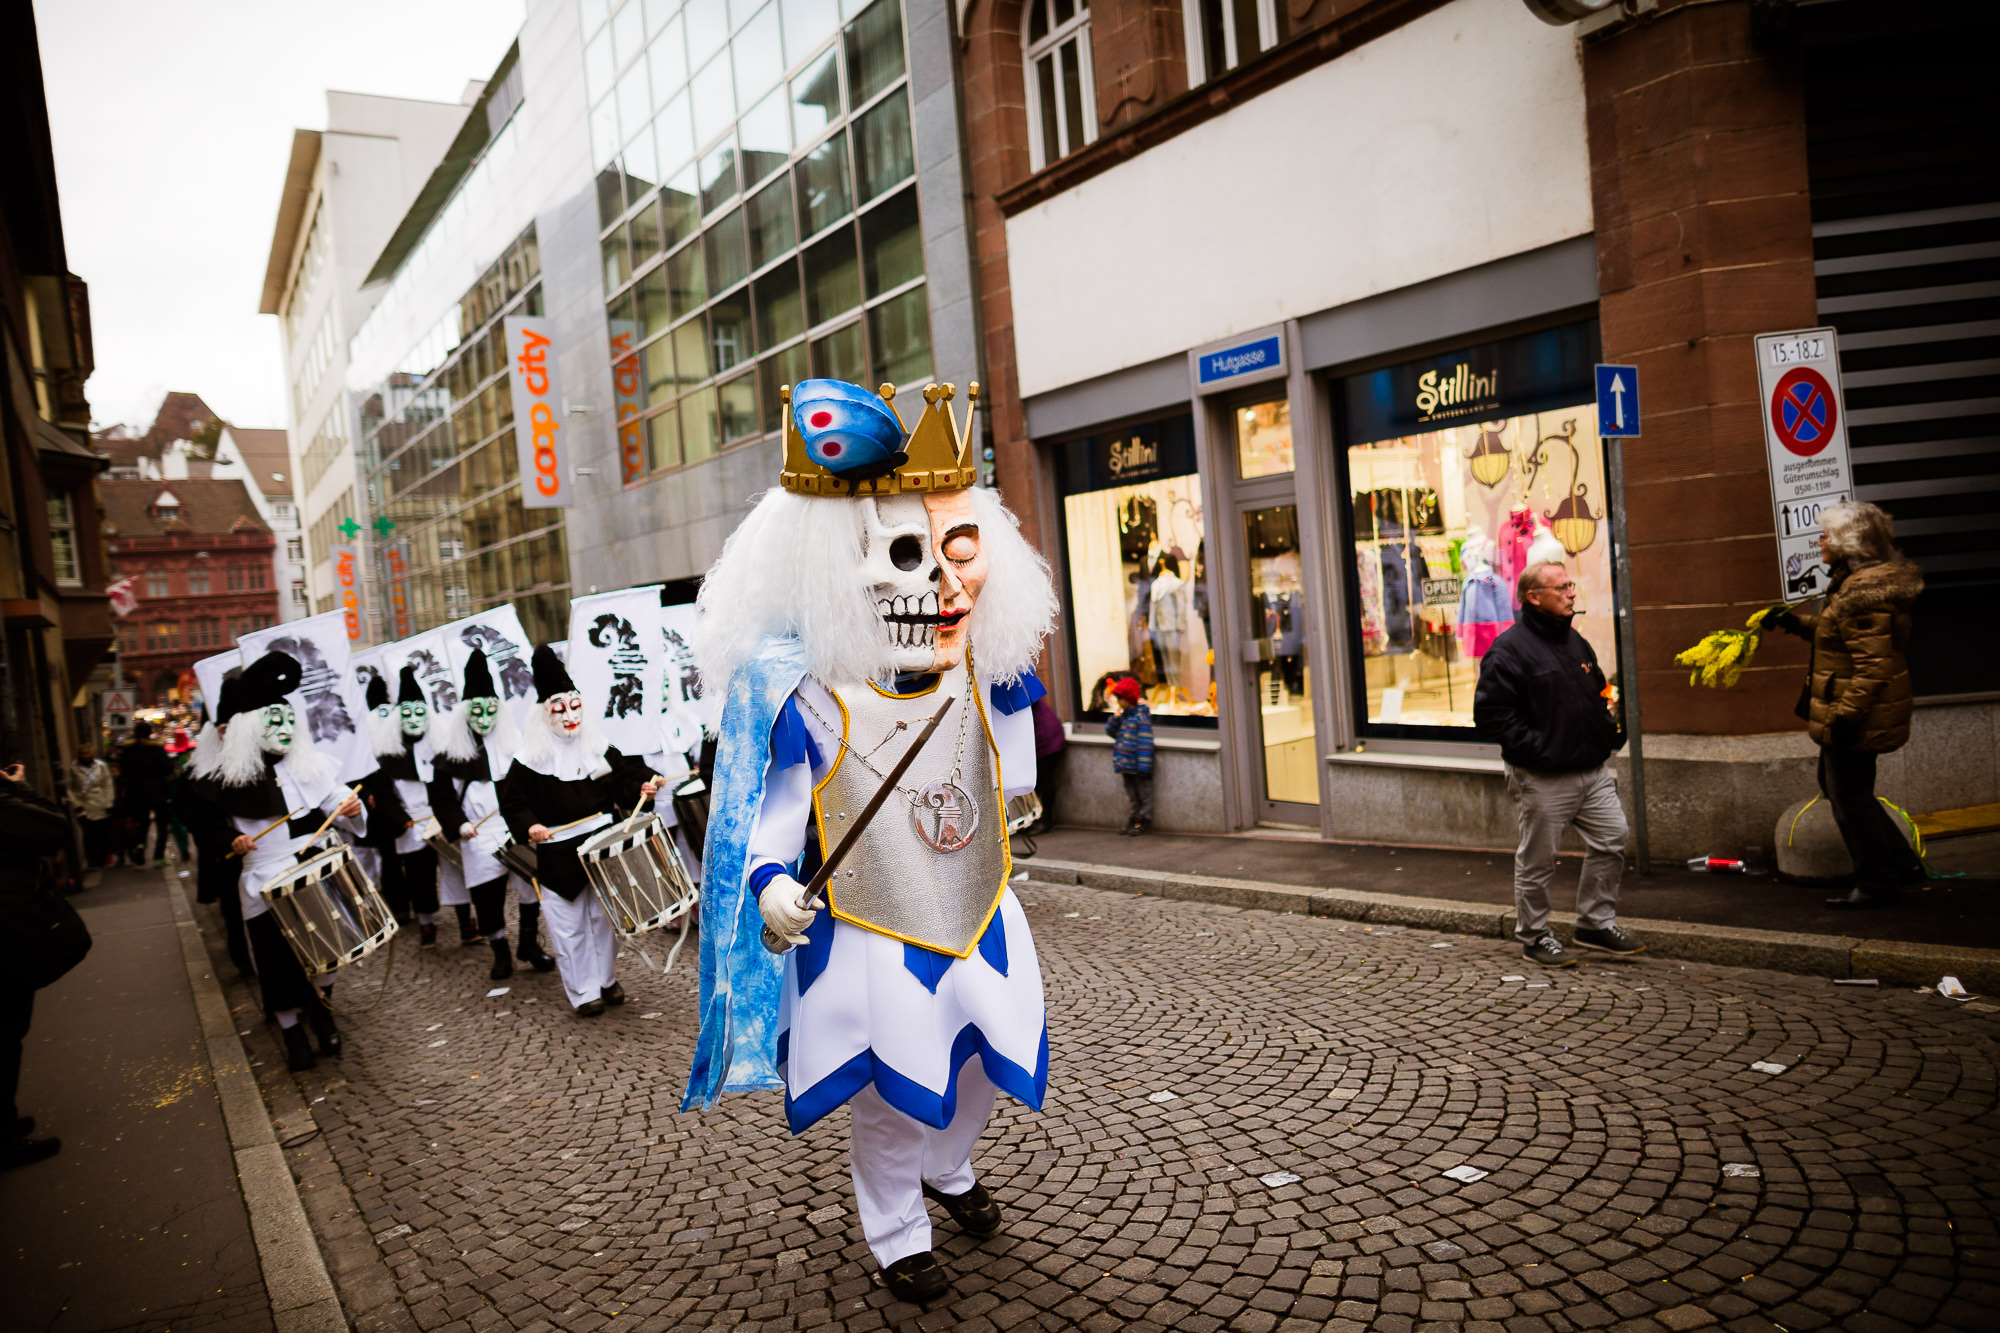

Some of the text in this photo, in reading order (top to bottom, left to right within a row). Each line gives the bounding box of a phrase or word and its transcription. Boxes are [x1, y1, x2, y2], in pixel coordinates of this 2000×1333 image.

[1211, 349, 1265, 374] Hutgasse
[1416, 362, 1498, 416] Stillini
[518, 329, 560, 497] coop city
[1109, 436, 1157, 474] Stillini
[1783, 467, 1840, 485] Güterumschlag
[1424, 580, 1457, 596] OPEN
